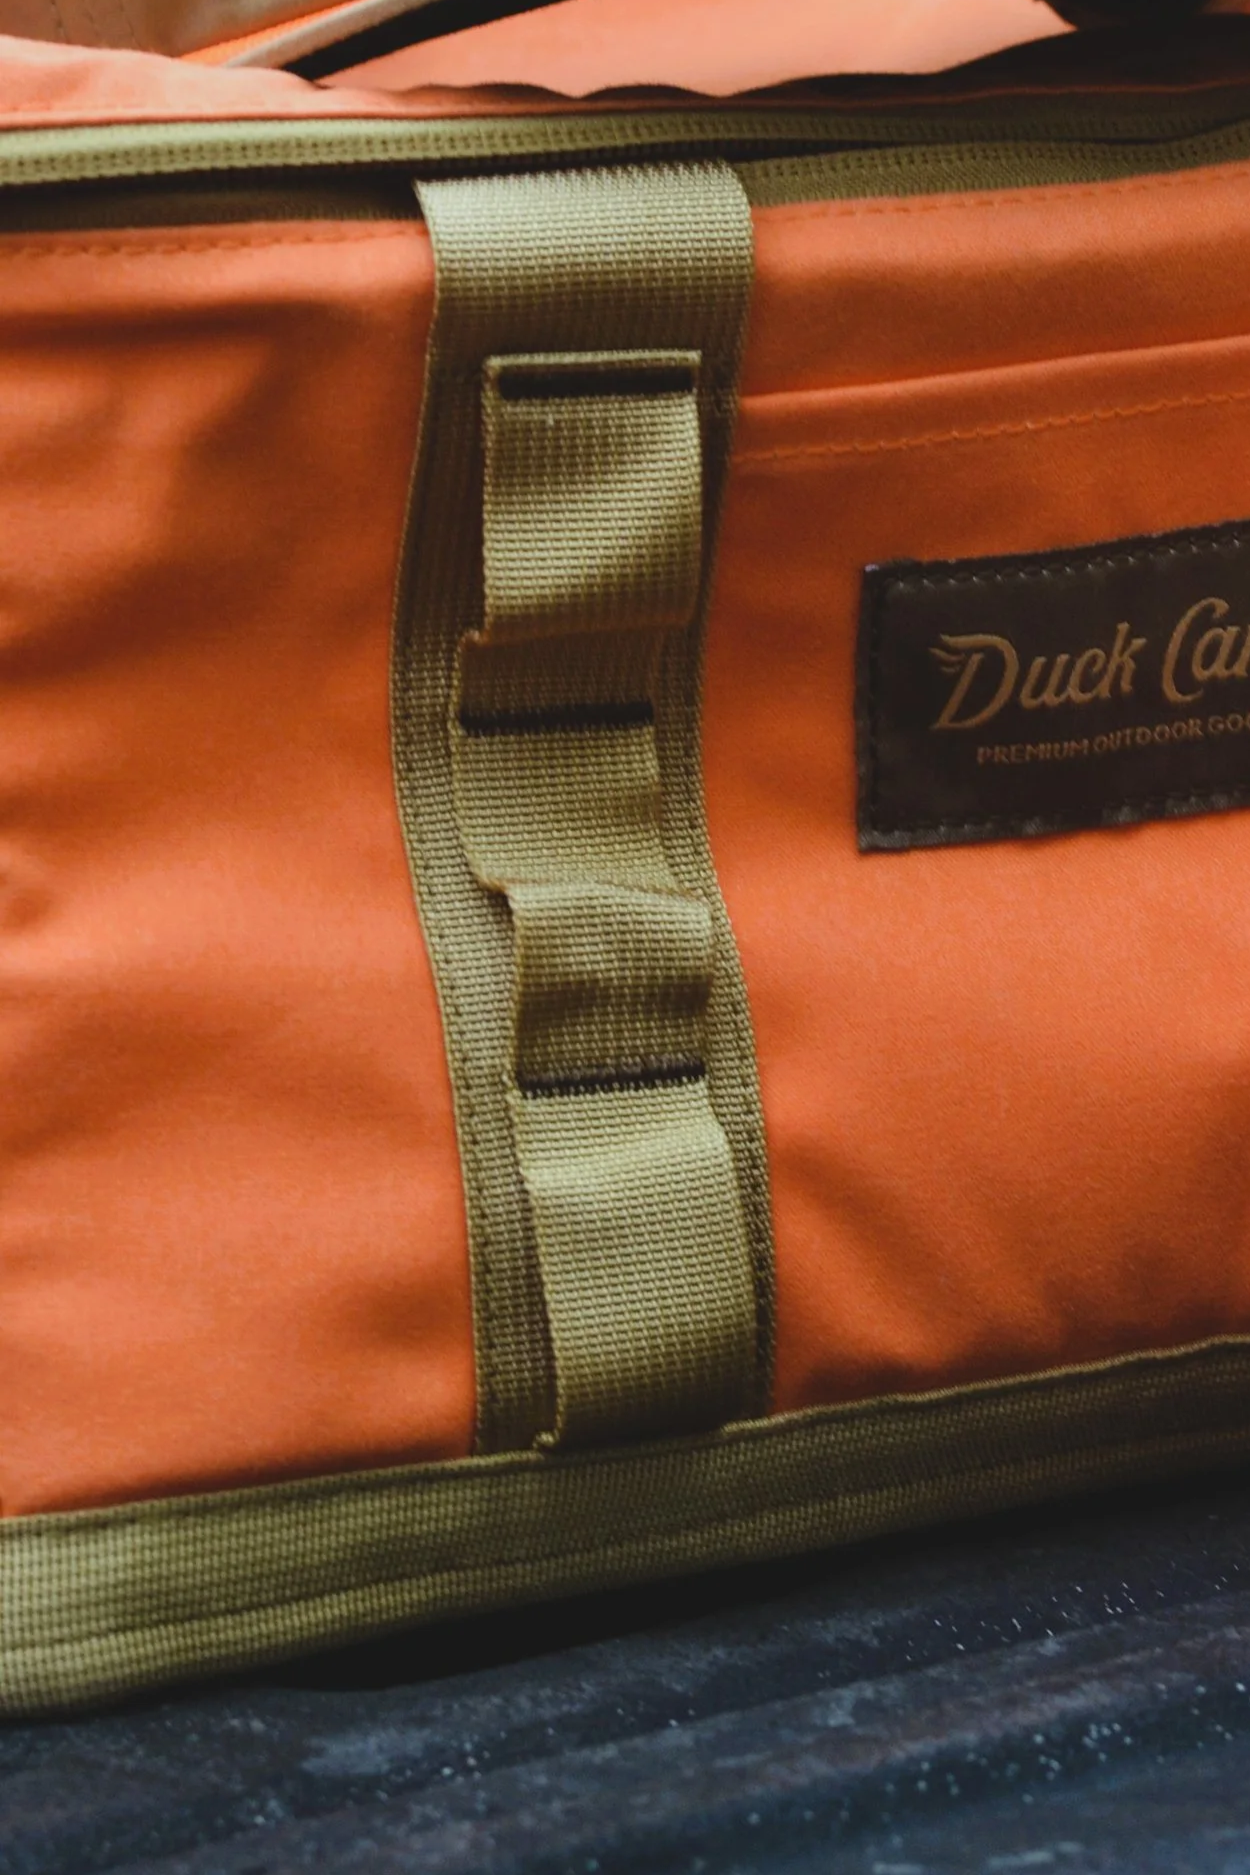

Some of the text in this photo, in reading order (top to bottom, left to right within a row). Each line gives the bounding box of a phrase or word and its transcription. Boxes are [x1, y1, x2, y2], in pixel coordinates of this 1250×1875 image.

[930, 622, 1147, 731] Duck
[975, 737, 1088, 765] PREMIUM
[1093, 718, 1203, 752] OUTDOOR
